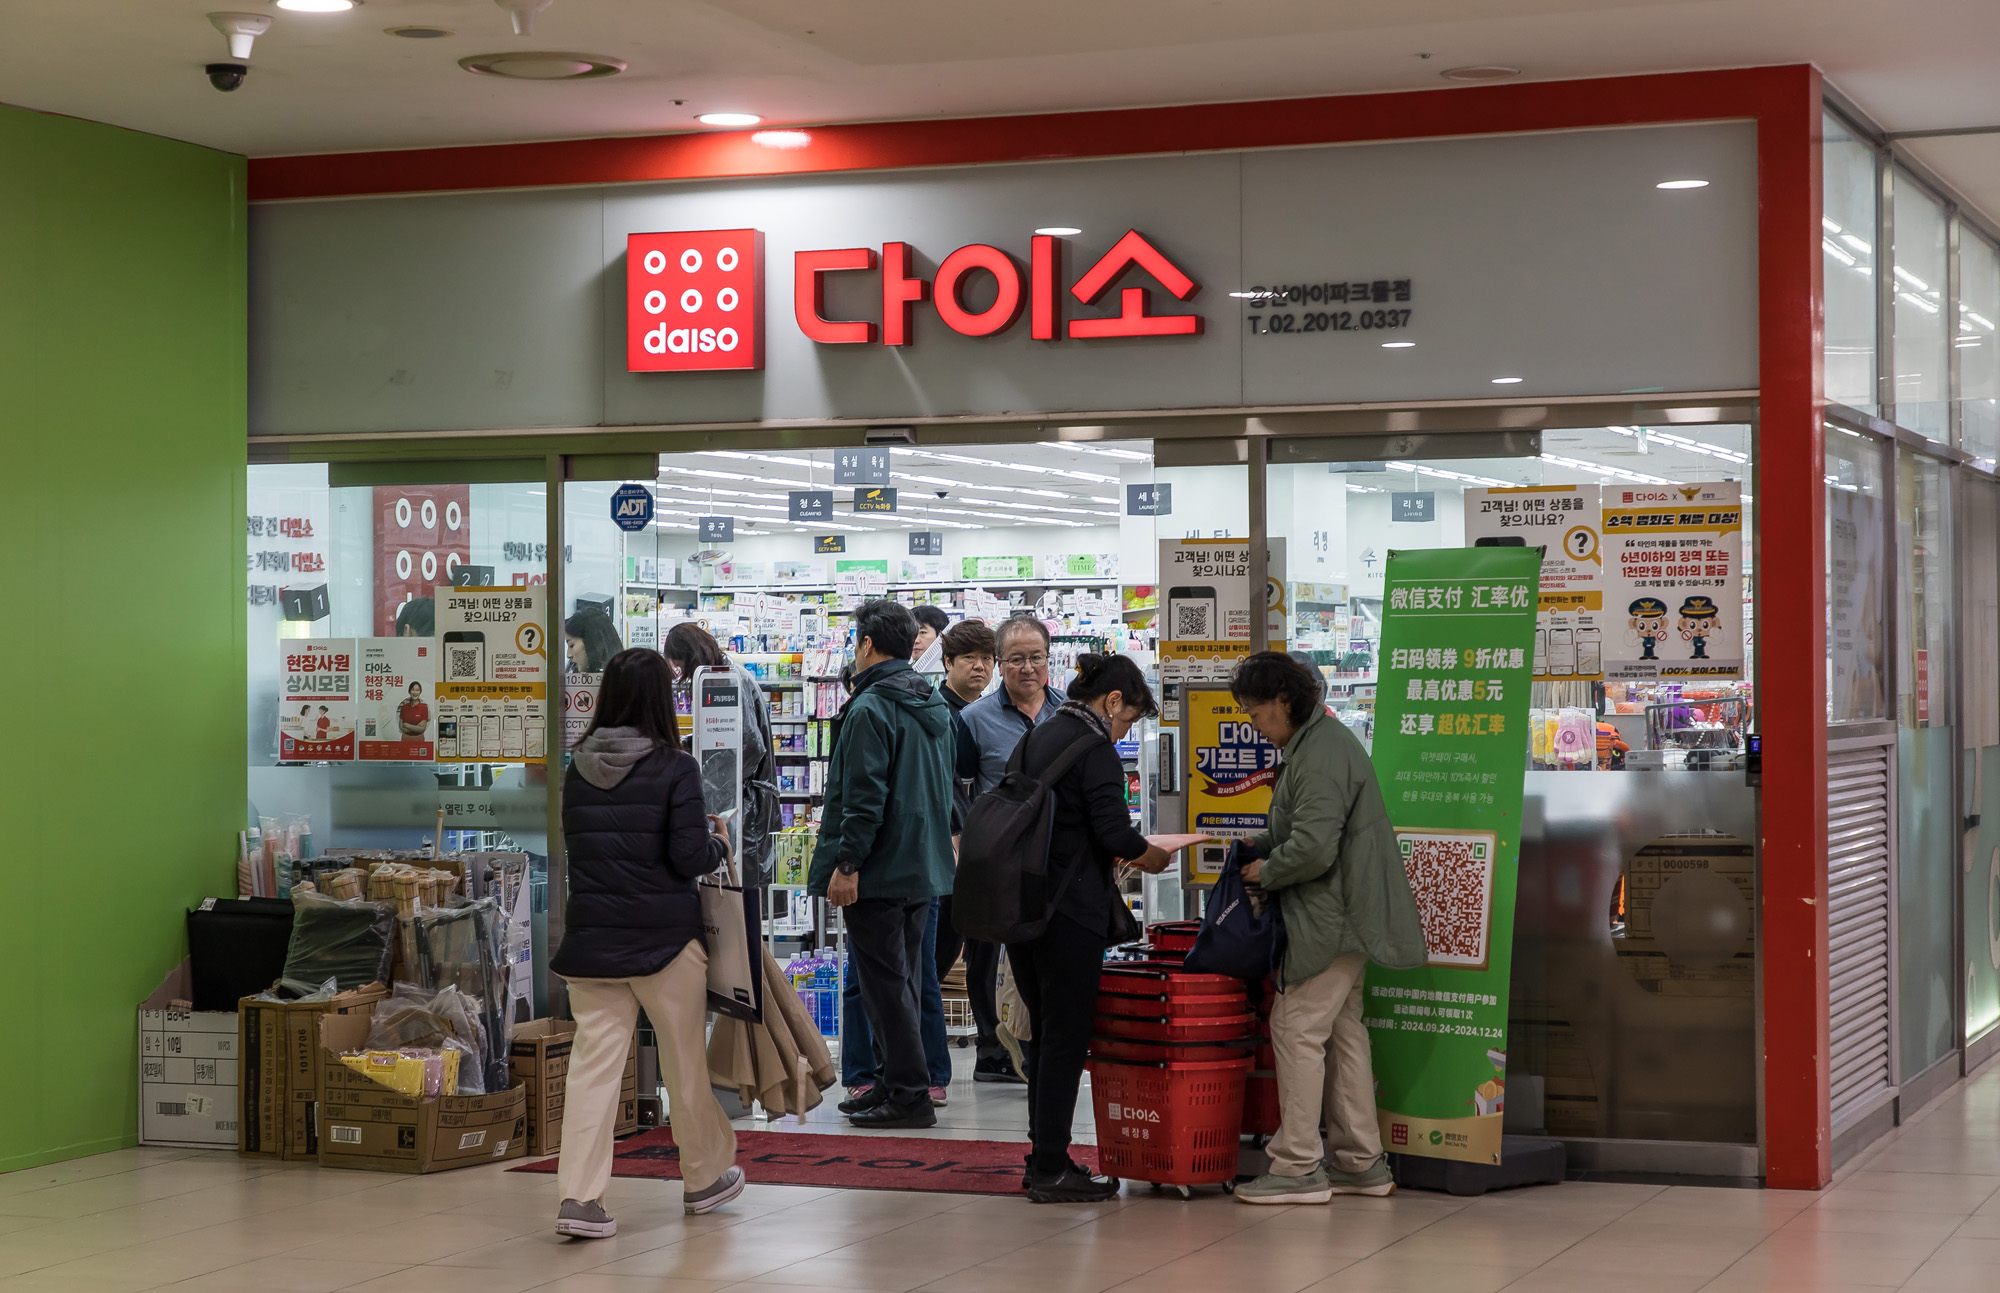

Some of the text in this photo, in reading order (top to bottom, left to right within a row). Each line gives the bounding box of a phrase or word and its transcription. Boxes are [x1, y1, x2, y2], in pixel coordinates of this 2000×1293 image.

[794, 229, 1205, 347] 다이소
[1248, 309, 1412, 335] T.02.2012.0337
[643, 321, 739, 354] daiso
[841, 455, 858, 468] 욕실
[1635, 492, 1668, 501] 다이소
[617, 499, 648, 516] ADT
[799, 498, 822, 508] 청소
[1403, 499, 1424, 509] 리빙
[1480, 498, 1584, 513] 고객님! 어떤 상품을
[1500, 514, 1565, 527] 찾으시나요?
[1607, 512, 1740, 528] 소액 범죄도 처벌 대상!
[707, 523, 726, 532] 공구
[1637, 540, 1657, 548] 타인의
[1175, 551, 1210, 563] 고객님!
[1214, 550, 1235, 563] 어떤
[1621, 550, 1730, 563] 6년이하의 징역 또는
[1622, 564, 1728, 578] 1천만원 이하의 벌금
[859, 576, 867, 588] 11
[1685, 579, 1713, 587] 있습니다.
[448, 597, 533, 609] 고객님! 어떤 상품을
[1390, 585, 1529, 610] 微信支付 汇率优
[758, 598, 765, 613] 9
[464, 611, 517, 622] 찾으시나요?
[286, 654, 350, 673] 현장사원
[1391, 648, 1525, 670] 扫码领券 9折优惠
[365, 662, 392, 674] 다이소
[286, 675, 350, 693] 상시모집
[365, 676, 404, 687] 현장 직원
[566, 675, 593, 685] 10:00
[365, 689, 384, 701] 채용
[1406, 679, 1504, 701] 最高优惠5元
[1212, 706, 1233, 714] 선물용
[565, 720, 589, 729] CCTV
[1400, 713, 1506, 736] 还享 超优汇率
[1197, 748, 1258, 770] 기프트
[1461, 792, 1477, 803] 사용
[444, 803, 476, 815] 열린 후
[1202, 816, 1265, 825] 카운터에서 구매가능
[1663, 859, 1709, 870] 0000598
[298, 1028, 309, 1074] 1011706
[445, 1098, 464, 1109] 입수
[470, 1098, 484, 1109] 10입
[440, 1115, 464, 1125] 제조일자
[1123, 1107, 1161, 1123] 다이소
[1121, 1126, 1150, 1140] 매장용
